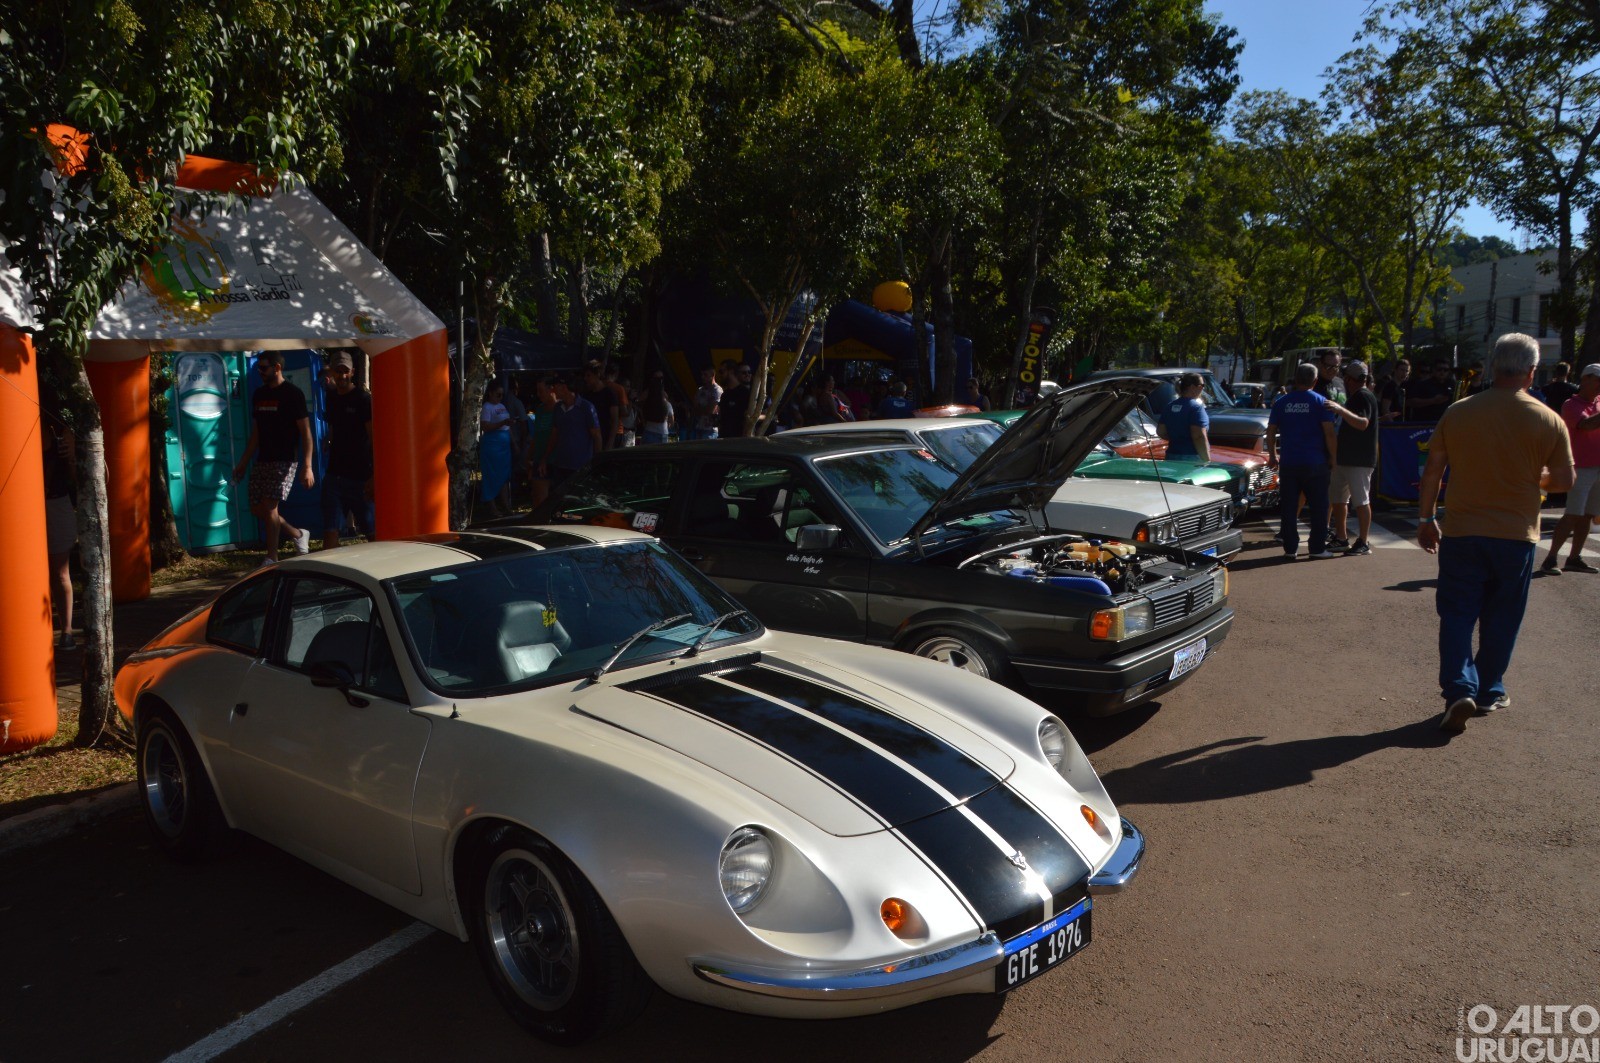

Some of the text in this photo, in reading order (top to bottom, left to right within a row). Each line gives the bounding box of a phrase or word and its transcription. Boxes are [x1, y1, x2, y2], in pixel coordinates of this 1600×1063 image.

[200, 284, 291, 304] A nossa Rádio
[1020, 331, 1042, 384] FOTO
[1042, 919, 1058, 933] BRASIL
[1007, 918, 1082, 985] GTE 1976
